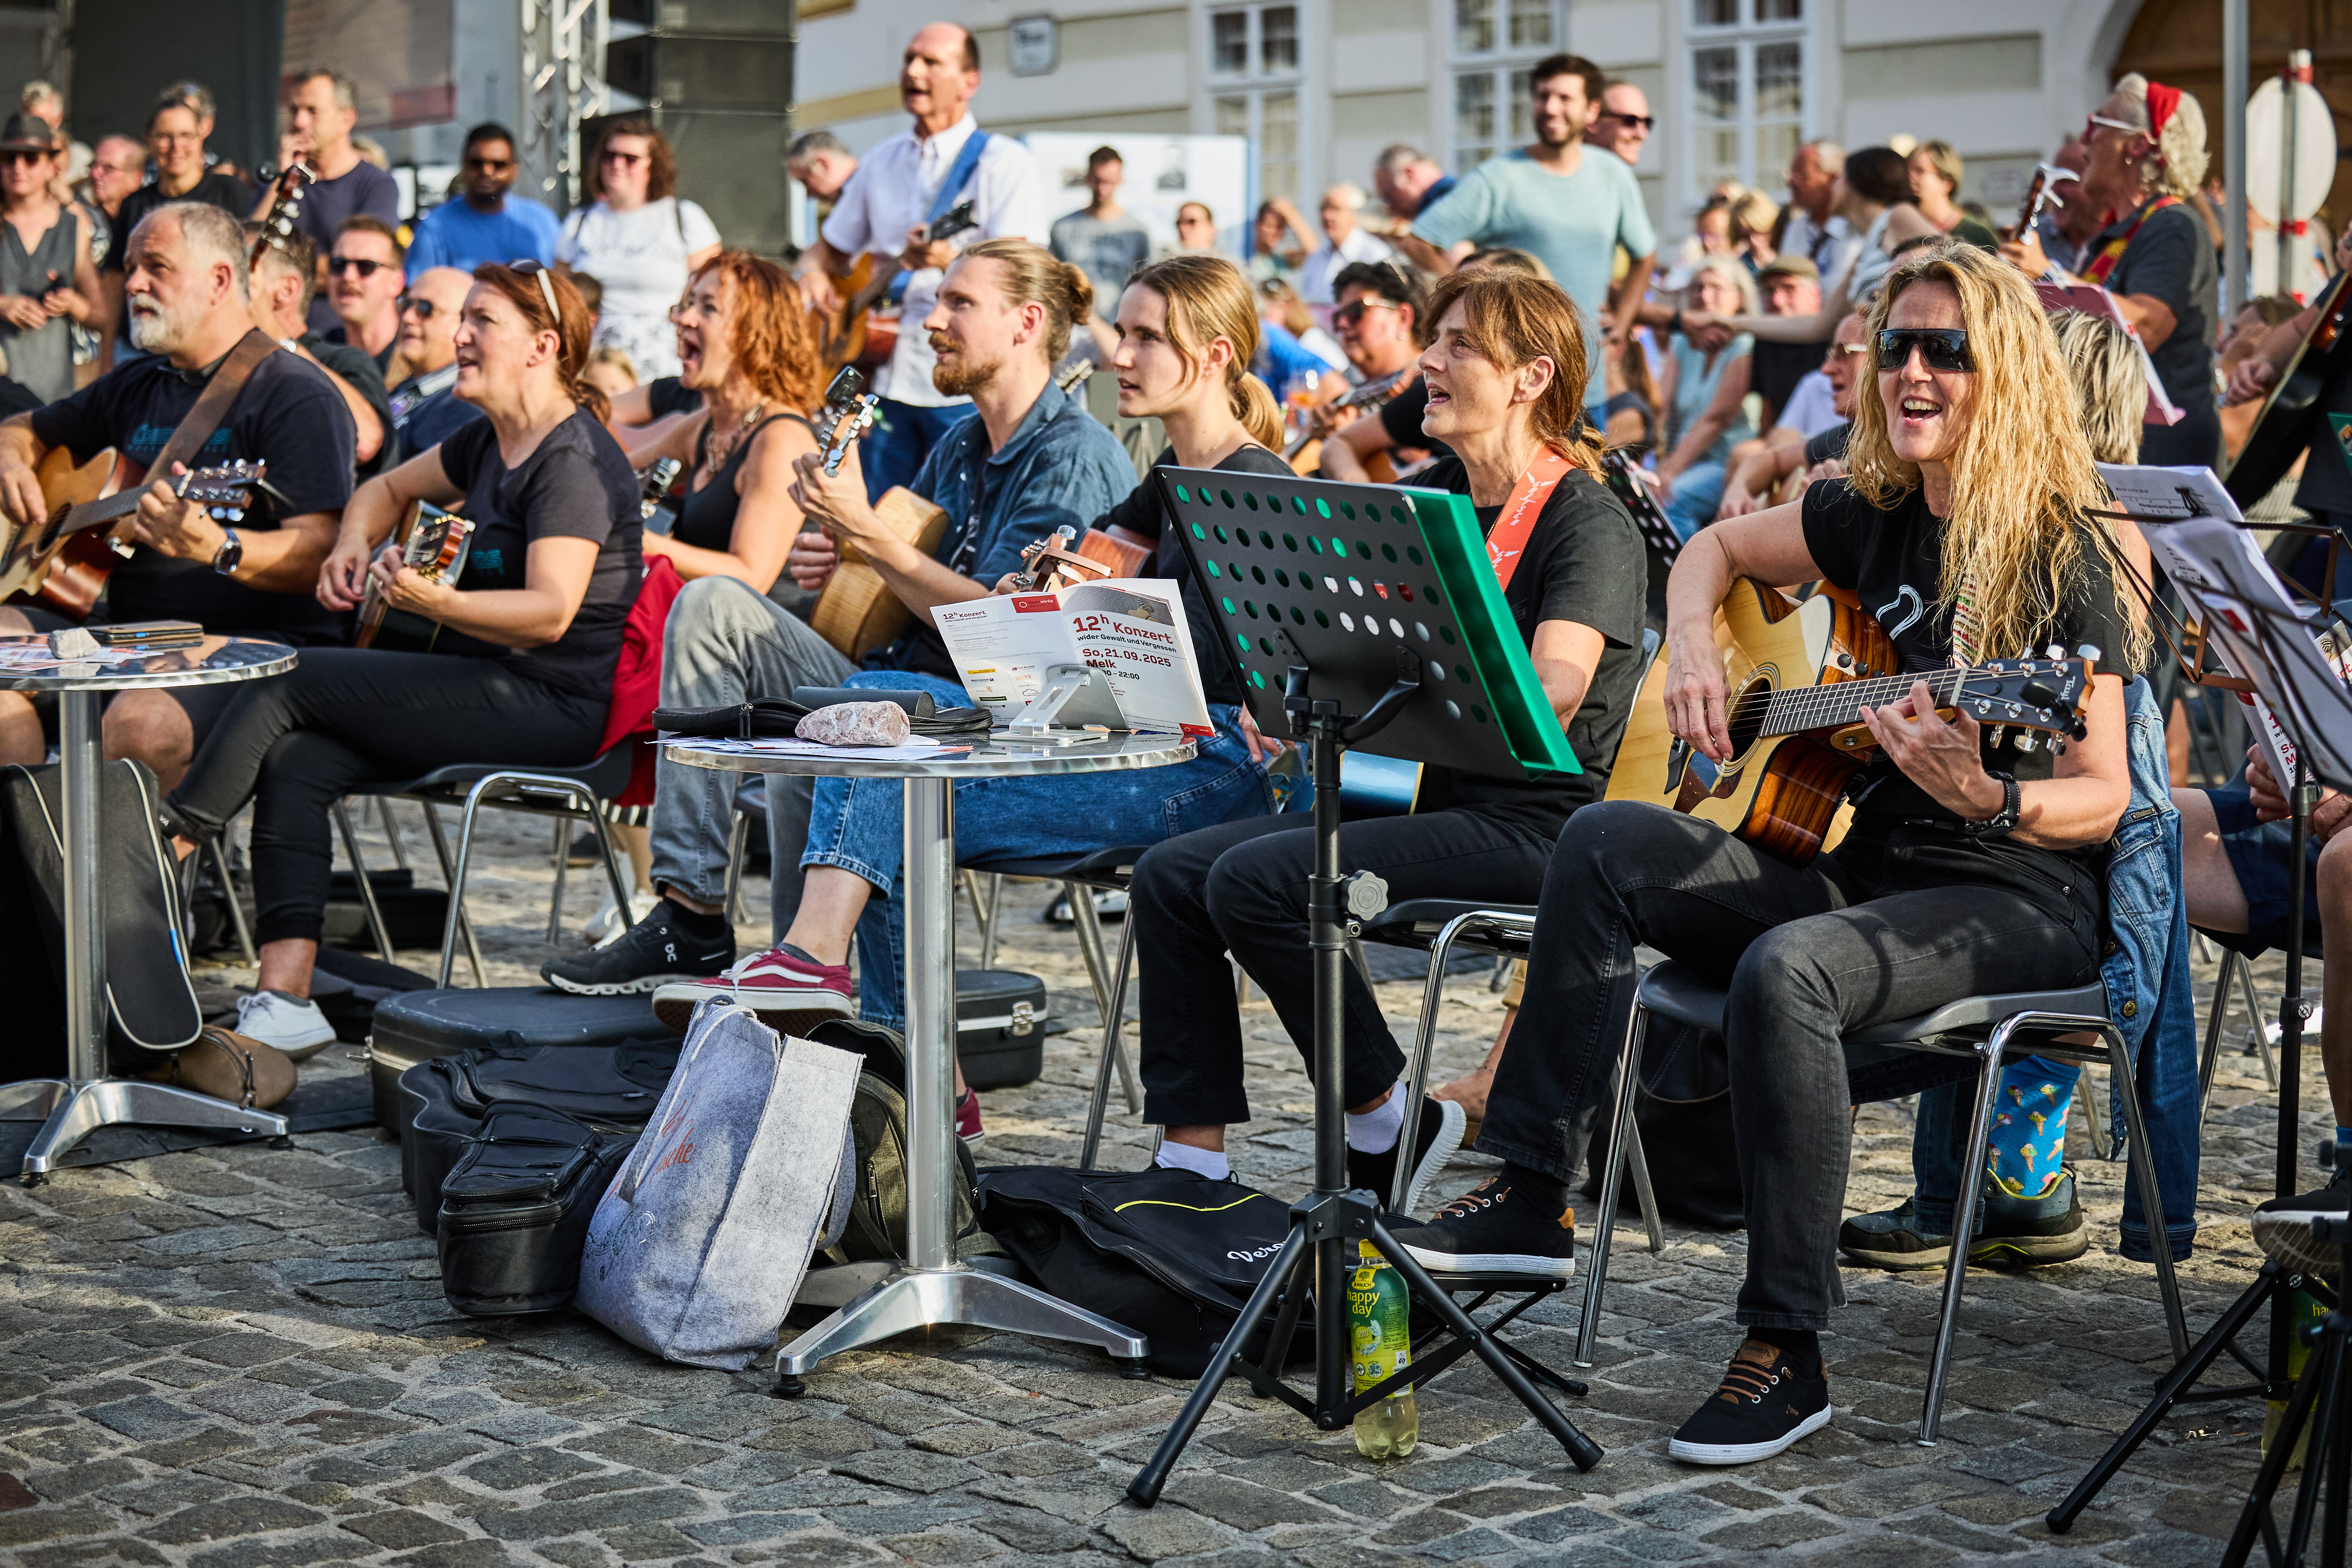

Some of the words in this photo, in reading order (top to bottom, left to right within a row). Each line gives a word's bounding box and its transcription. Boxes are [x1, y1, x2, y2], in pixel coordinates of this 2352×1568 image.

[1113, 622, 1174, 644] Konzert
[1140, 640, 1176, 653] Vergessen
[1086, 659, 1117, 669] Melk
[1118, 671, 1140, 680] 22:00
[2060, 675, 2076, 700] Tayl
[1227, 1240, 1286, 1262] Vero
[1347, 1288, 1380, 1306] happy
[1352, 1302, 1372, 1318] day
